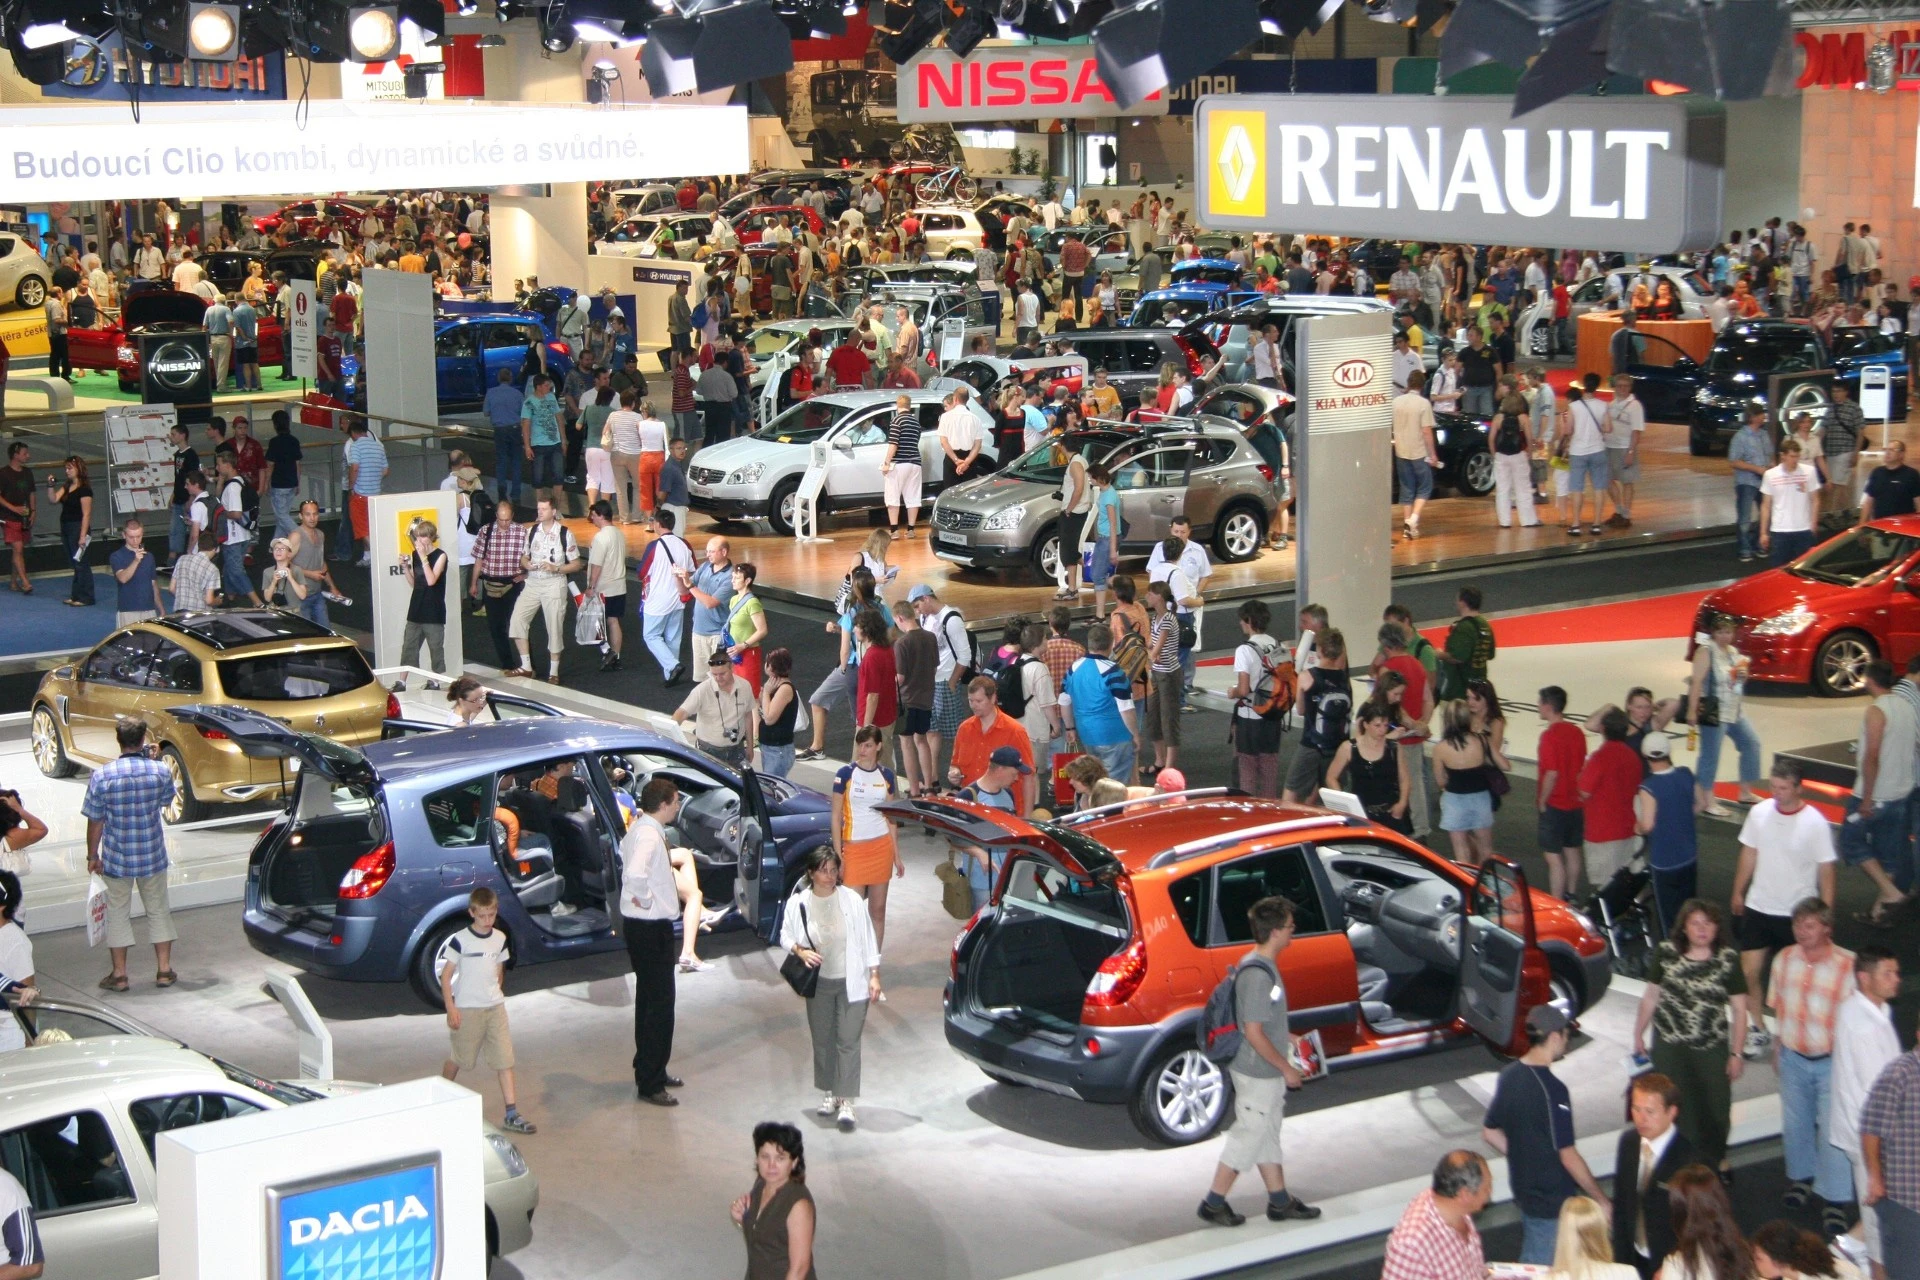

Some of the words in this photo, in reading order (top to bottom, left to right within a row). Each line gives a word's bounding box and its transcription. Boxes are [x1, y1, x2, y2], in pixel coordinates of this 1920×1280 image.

[918, 58, 1161, 109] NISSA
[13, 148, 151, 179] Budoucí
[163, 146, 224, 175] Clio
[235, 143, 336, 174] kombi,
[347, 137, 504, 174] dynamické
[513, 143, 528, 162] a
[538, 133, 645, 162] svůdné.
[1279, 124, 1670, 220] RENAULT
[295, 318, 308, 327] elis
[157, 361, 201, 372] NISSAN
[1341, 367, 1368, 382] KIA
[1315, 398, 1337, 410] KIA
[1341, 393, 1387, 408] MOTORS
[289, 1195, 429, 1247] DACIA
